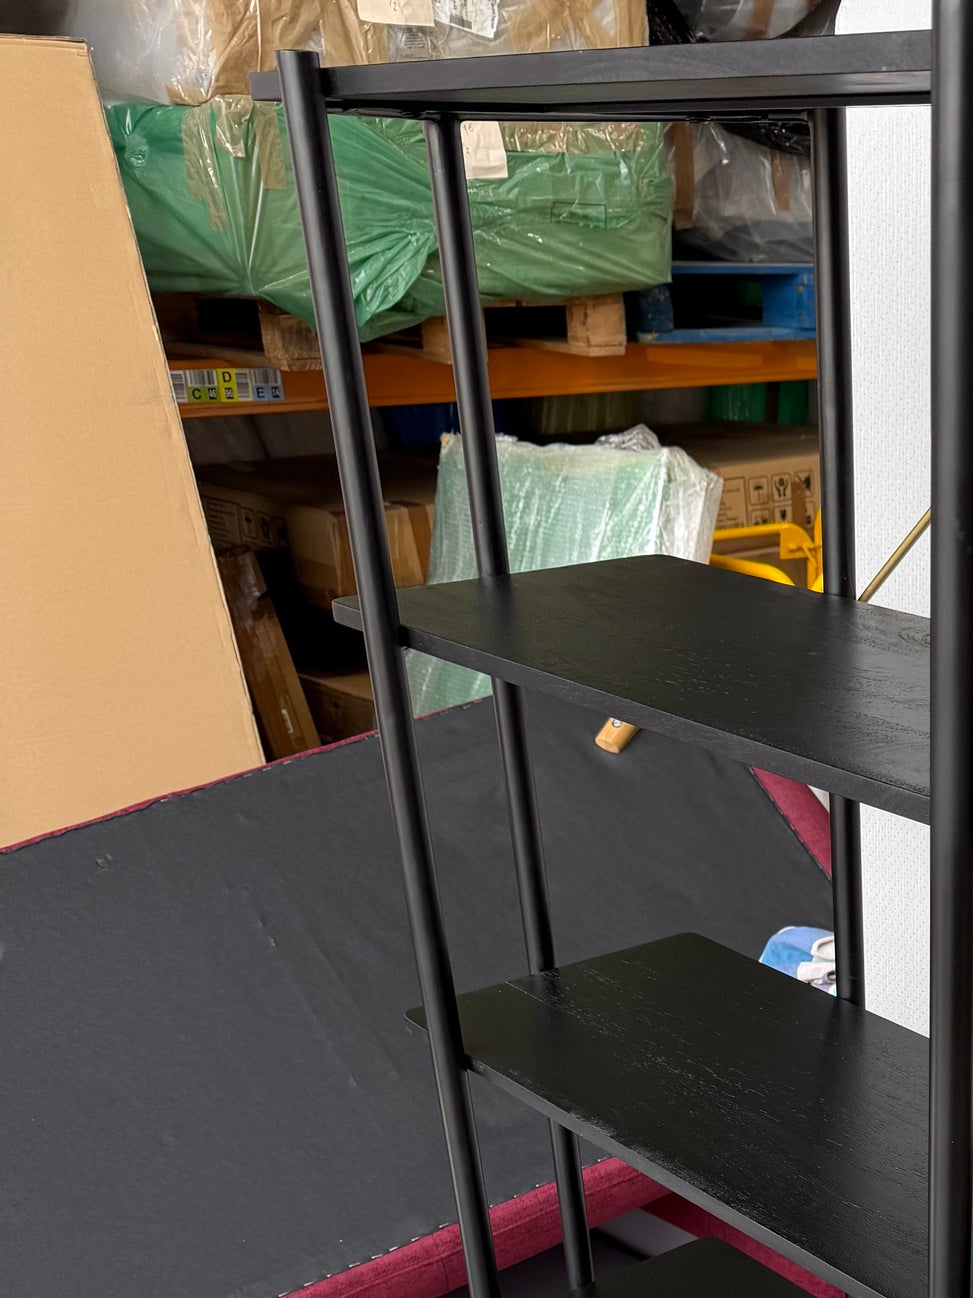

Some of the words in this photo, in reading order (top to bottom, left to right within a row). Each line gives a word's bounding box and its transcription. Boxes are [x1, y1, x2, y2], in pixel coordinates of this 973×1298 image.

[222, 371, 232, 382] D
[192, 388, 202, 399] C
[256, 387, 265, 398] E
